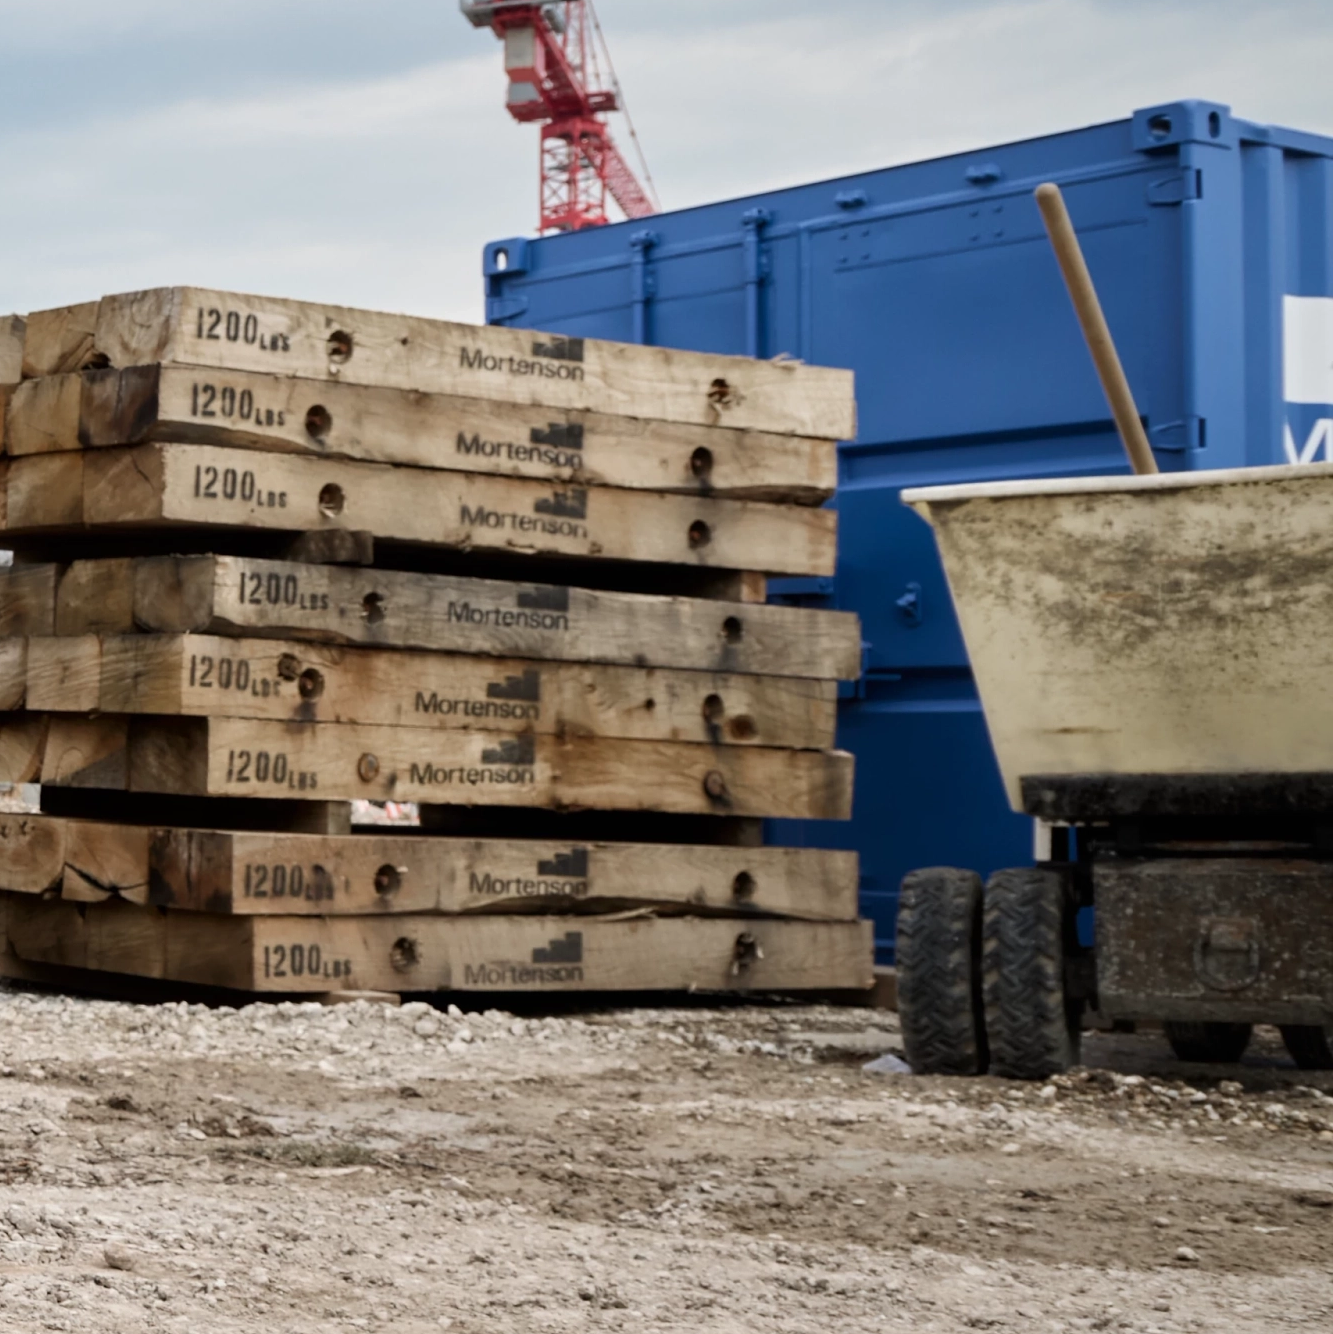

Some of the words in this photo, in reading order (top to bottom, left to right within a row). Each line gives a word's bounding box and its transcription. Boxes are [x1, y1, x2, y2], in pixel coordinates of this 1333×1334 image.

[459, 345, 584, 381] Mortenson
[456, 431, 583, 468] Mortenson
[460, 503, 588, 540] Mortenson
[447, 600, 569, 631] Mortenson
[415, 690, 540, 721] Mortenson
[410, 762, 535, 785] Mortenson
[469, 871, 588, 897] Mortenson
[463, 963, 583, 985] Mortenson
